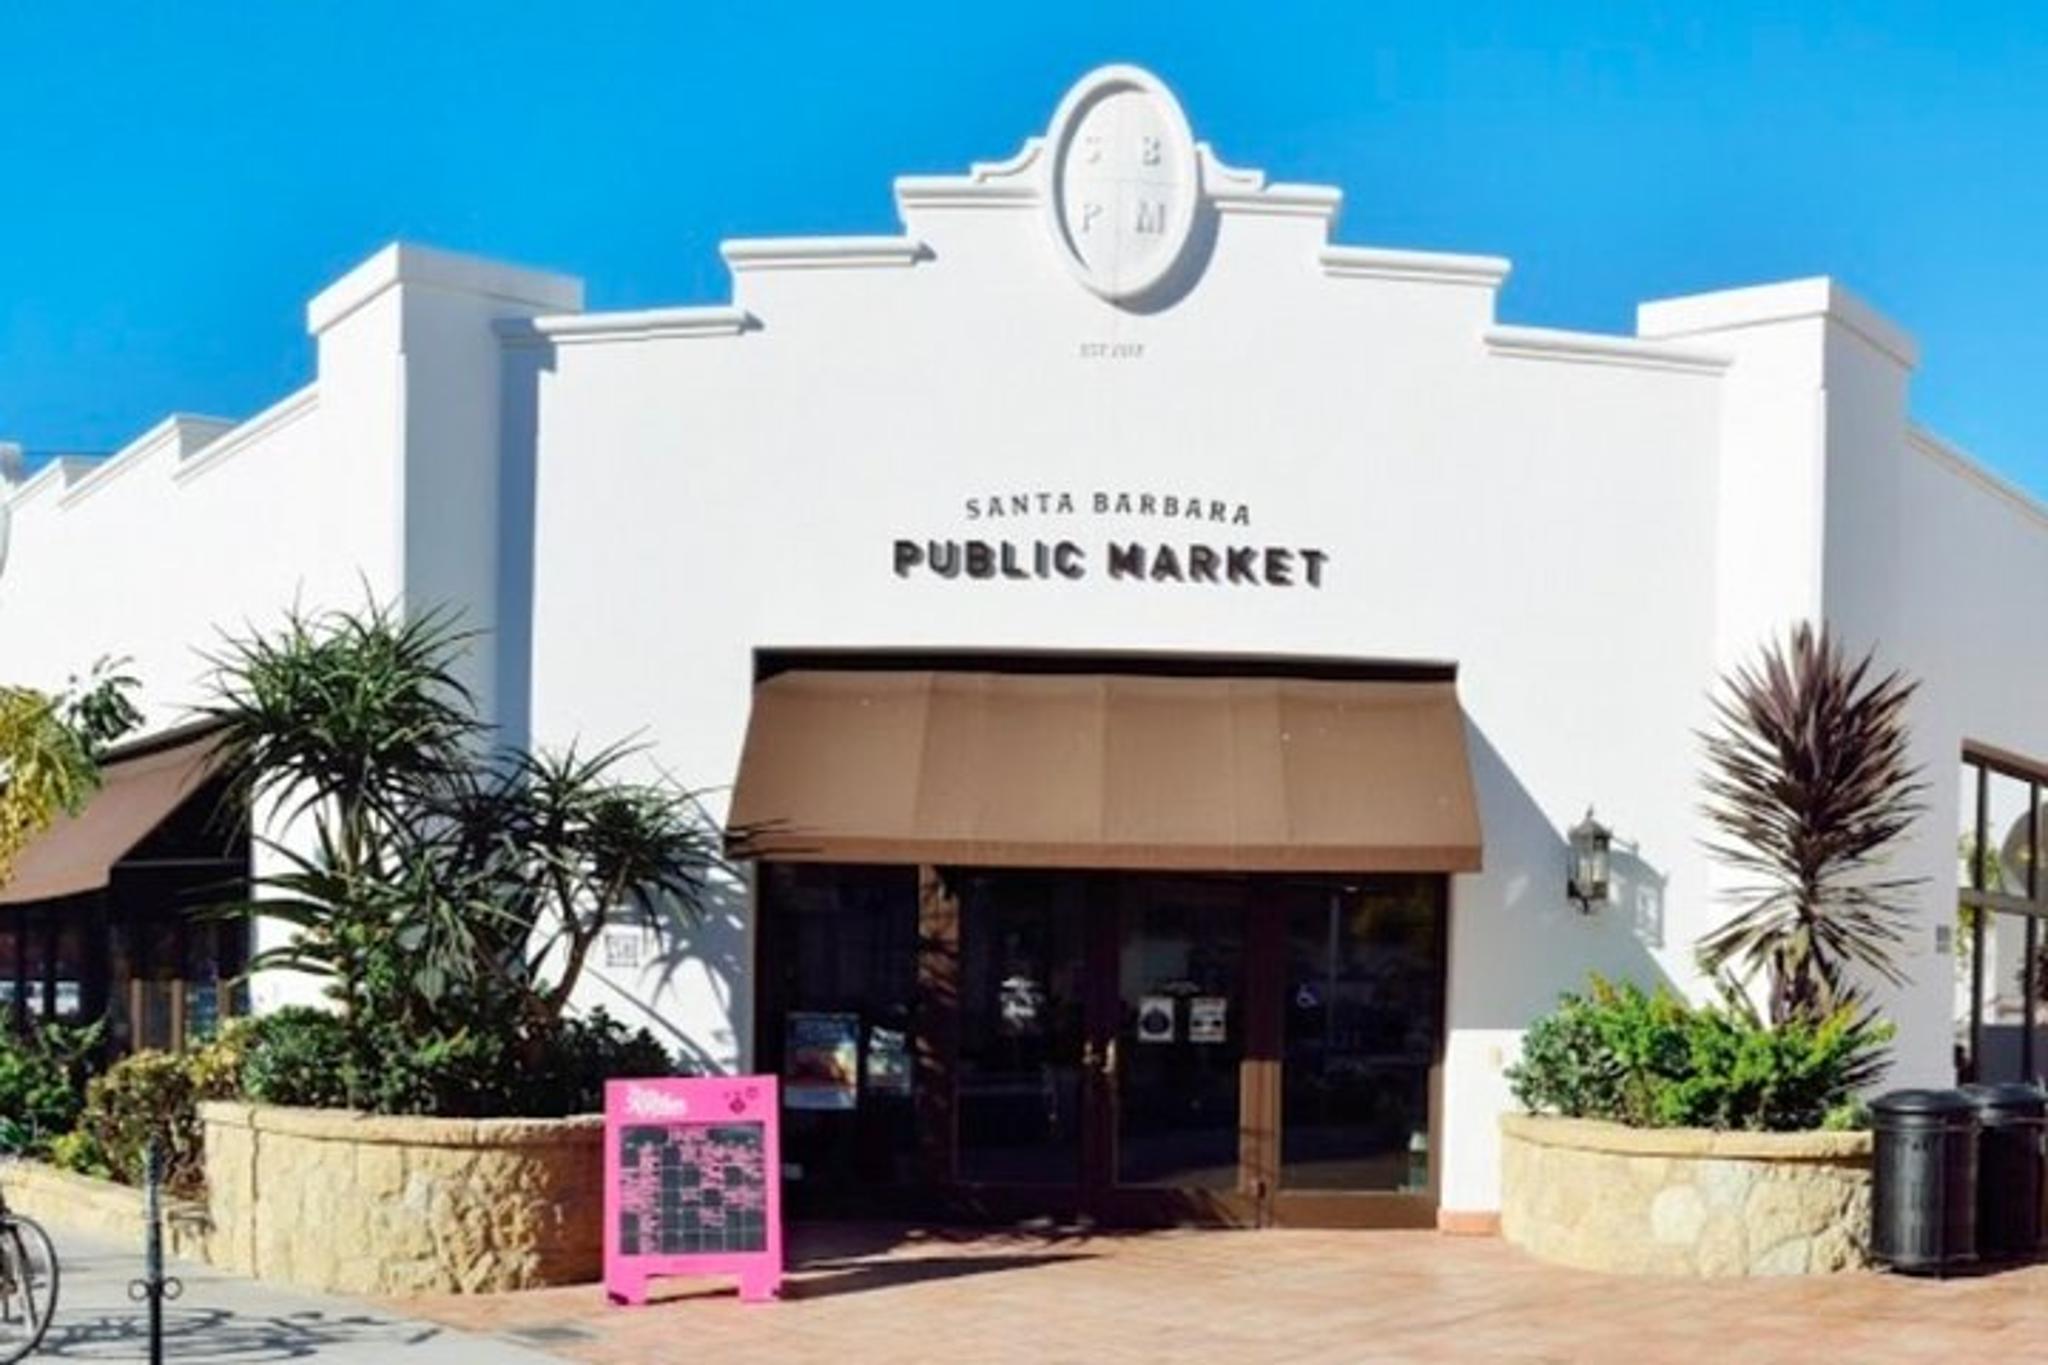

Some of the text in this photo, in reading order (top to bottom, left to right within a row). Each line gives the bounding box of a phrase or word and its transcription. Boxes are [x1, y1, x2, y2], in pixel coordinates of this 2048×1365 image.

[1142, 136, 1162, 166] B
[1082, 201, 1166, 235] P M
[966, 492, 1251, 526] SANTA BARBARA
[893, 539, 1329, 588] PUBLIC MARKET
